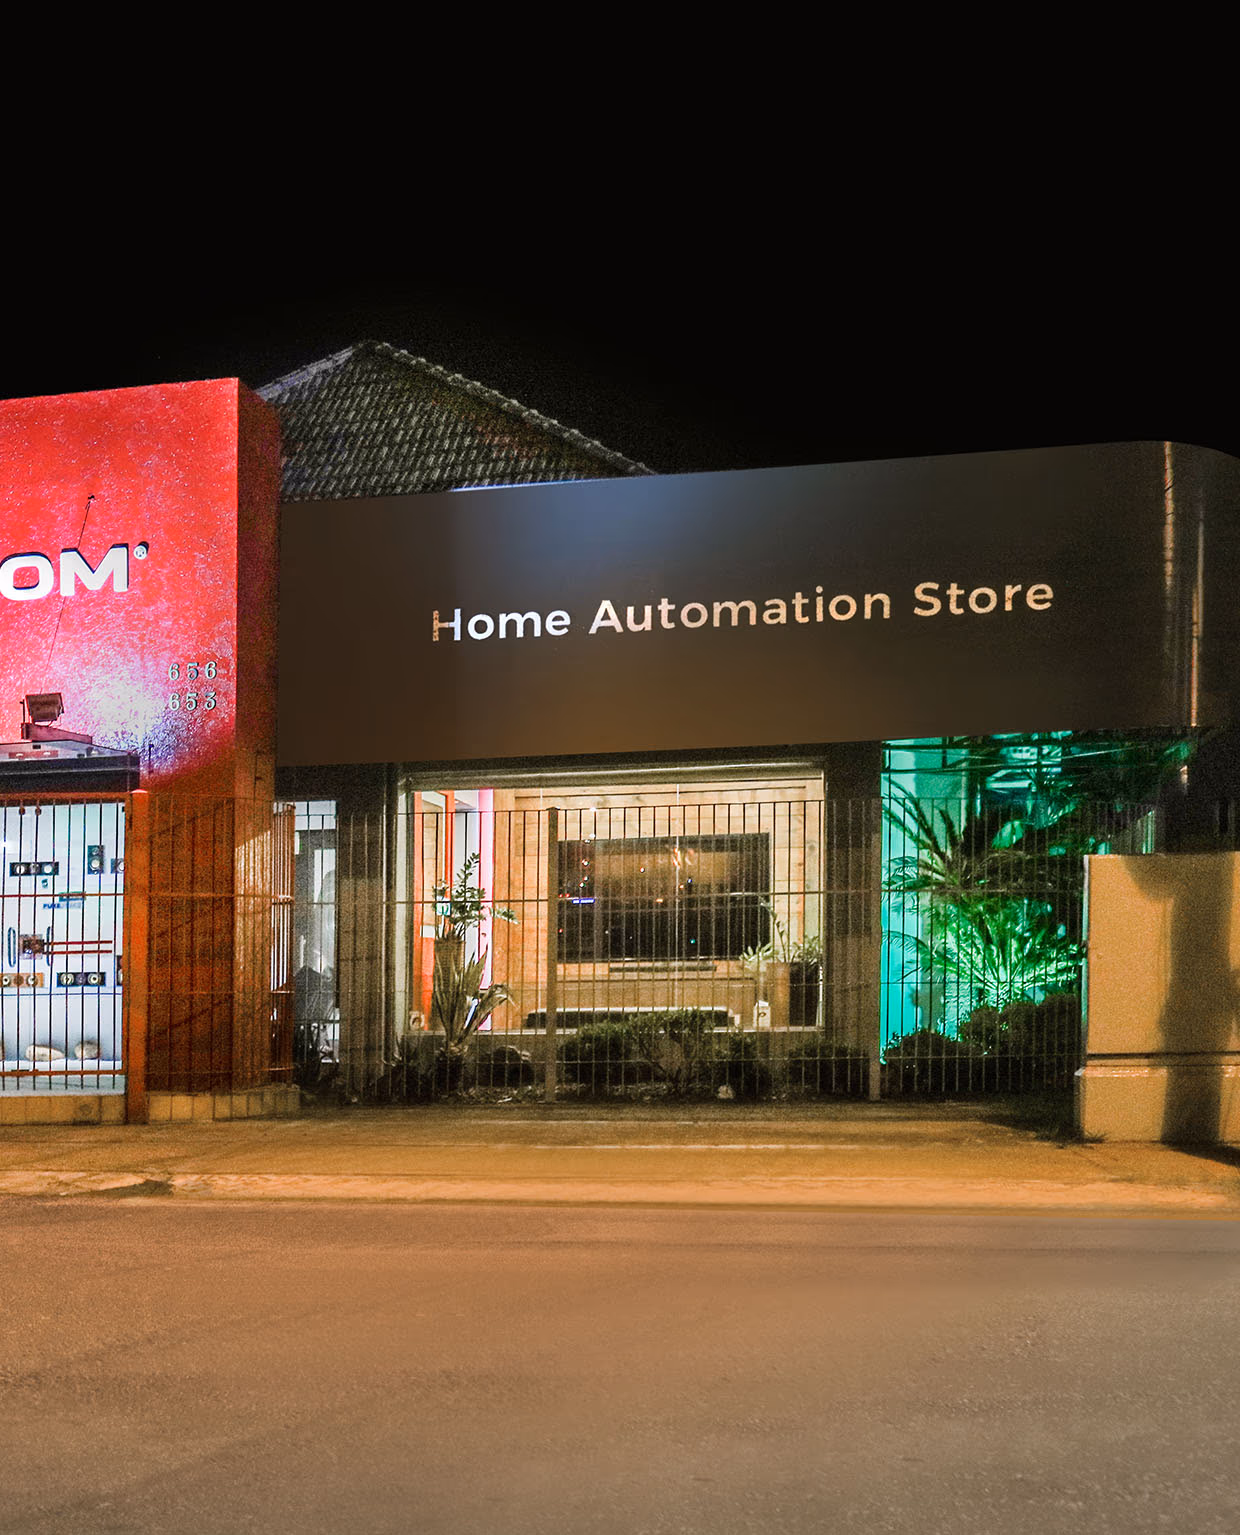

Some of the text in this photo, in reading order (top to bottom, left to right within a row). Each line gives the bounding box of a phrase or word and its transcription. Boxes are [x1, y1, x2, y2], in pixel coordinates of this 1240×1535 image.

[432, 581, 1054, 642] Home Automation Store
[168, 661, 218, 680] 656
[168, 692, 217, 711] 653
